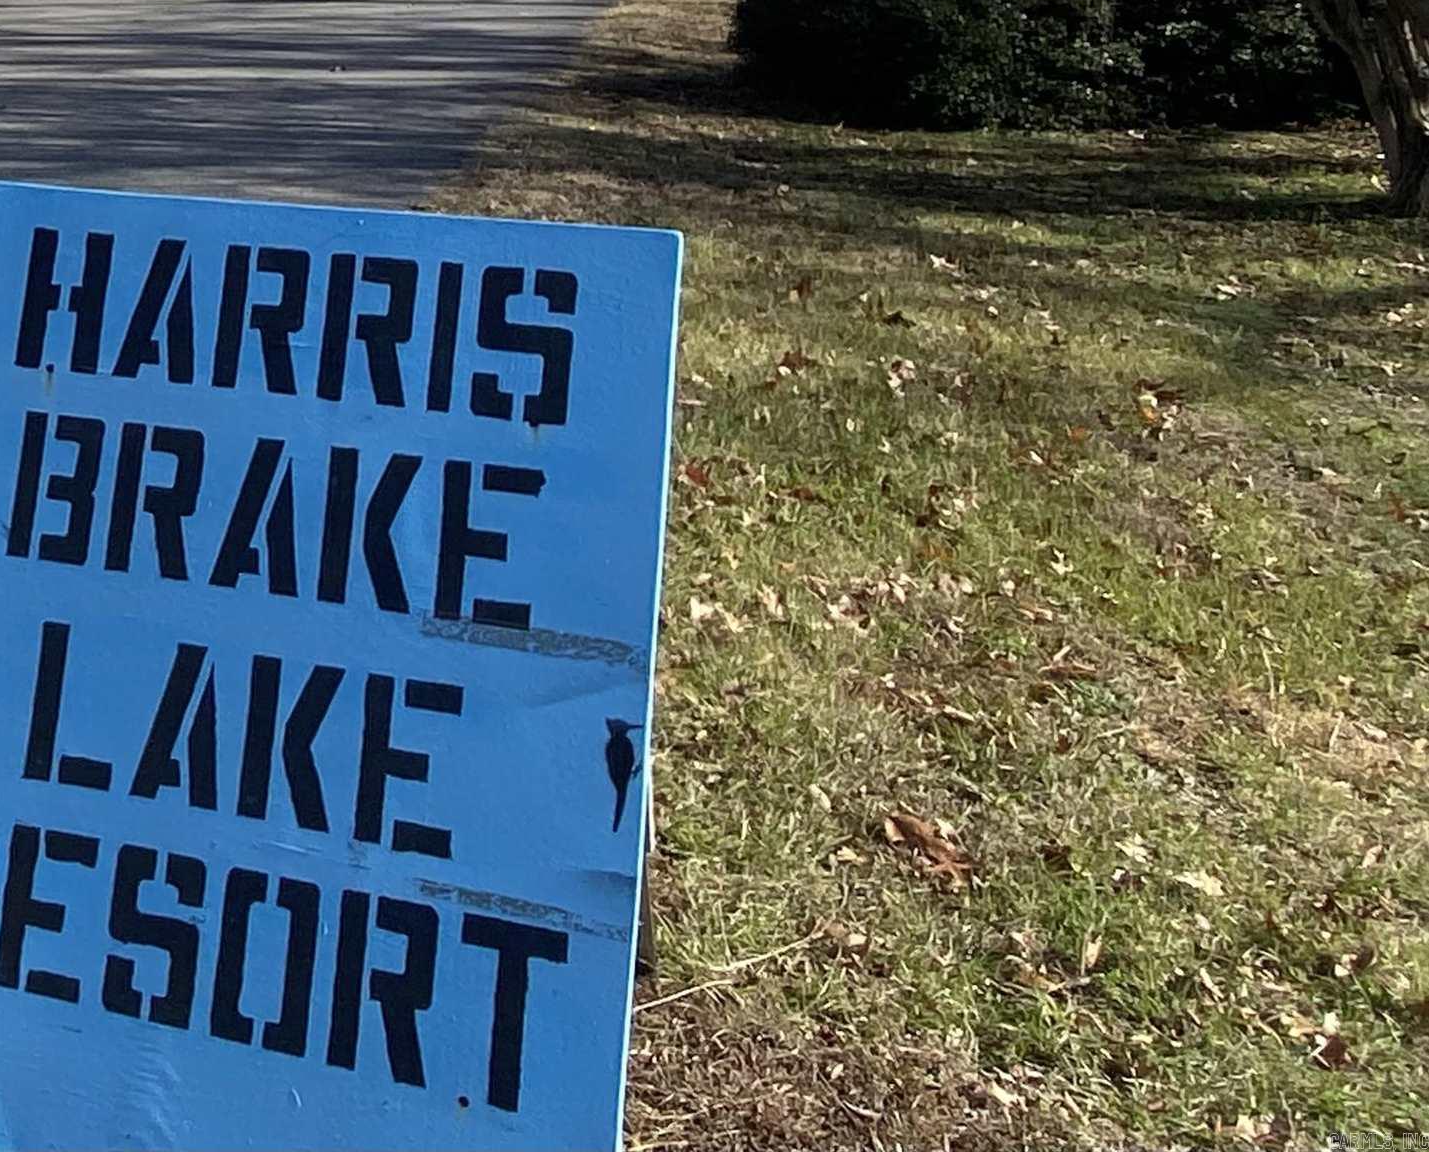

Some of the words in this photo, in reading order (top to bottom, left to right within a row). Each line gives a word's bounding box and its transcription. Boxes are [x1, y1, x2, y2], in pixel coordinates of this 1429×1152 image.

[15, 227, 579, 426] HARRIS
[5, 411, 546, 631] BRAKE
[21, 621, 464, 859] LAKE
